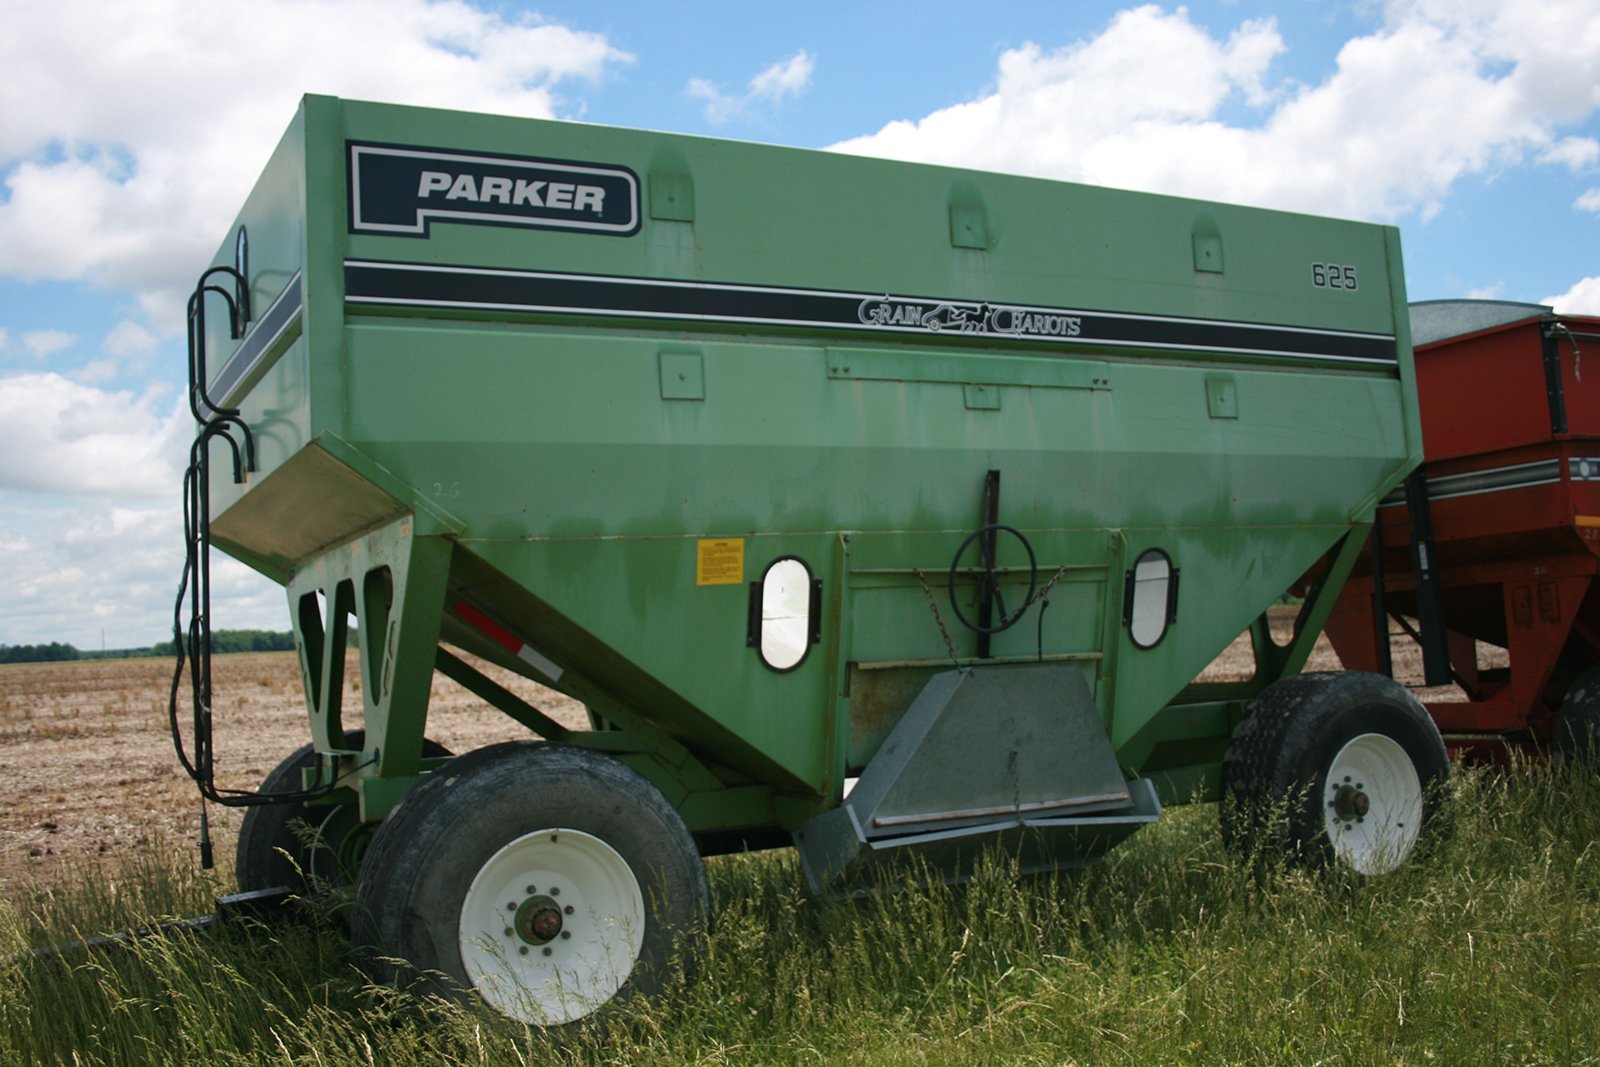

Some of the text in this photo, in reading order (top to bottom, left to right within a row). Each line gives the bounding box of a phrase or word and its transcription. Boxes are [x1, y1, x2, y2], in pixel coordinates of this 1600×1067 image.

[417, 171, 606, 213] PARKER
[1311, 262, 1358, 292] 625
[858, 293, 1081, 339] GRAIN CHARIOTS
